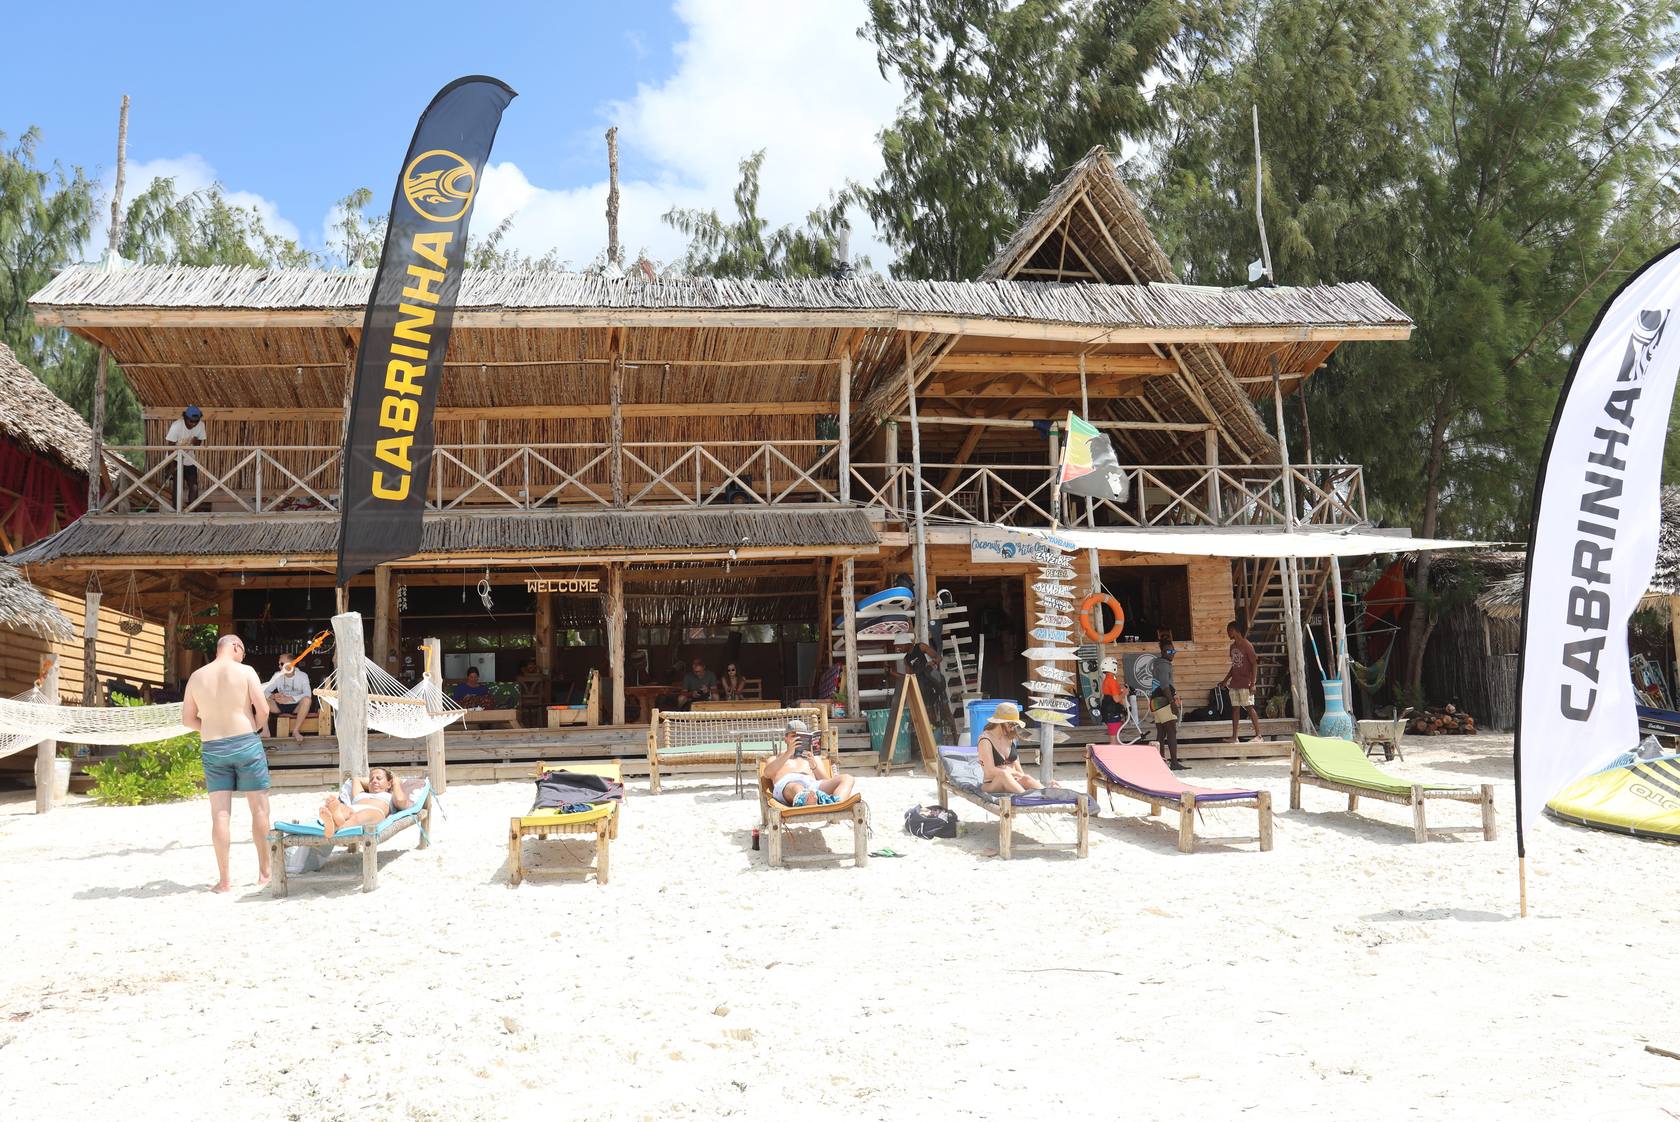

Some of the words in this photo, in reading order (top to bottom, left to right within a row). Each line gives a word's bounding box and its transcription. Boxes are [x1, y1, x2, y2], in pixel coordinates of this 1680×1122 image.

[371, 231, 454, 501] CABRINHA
[527, 580, 599, 593] WELCOME
[1560, 387, 1641, 722] CABRINHA
